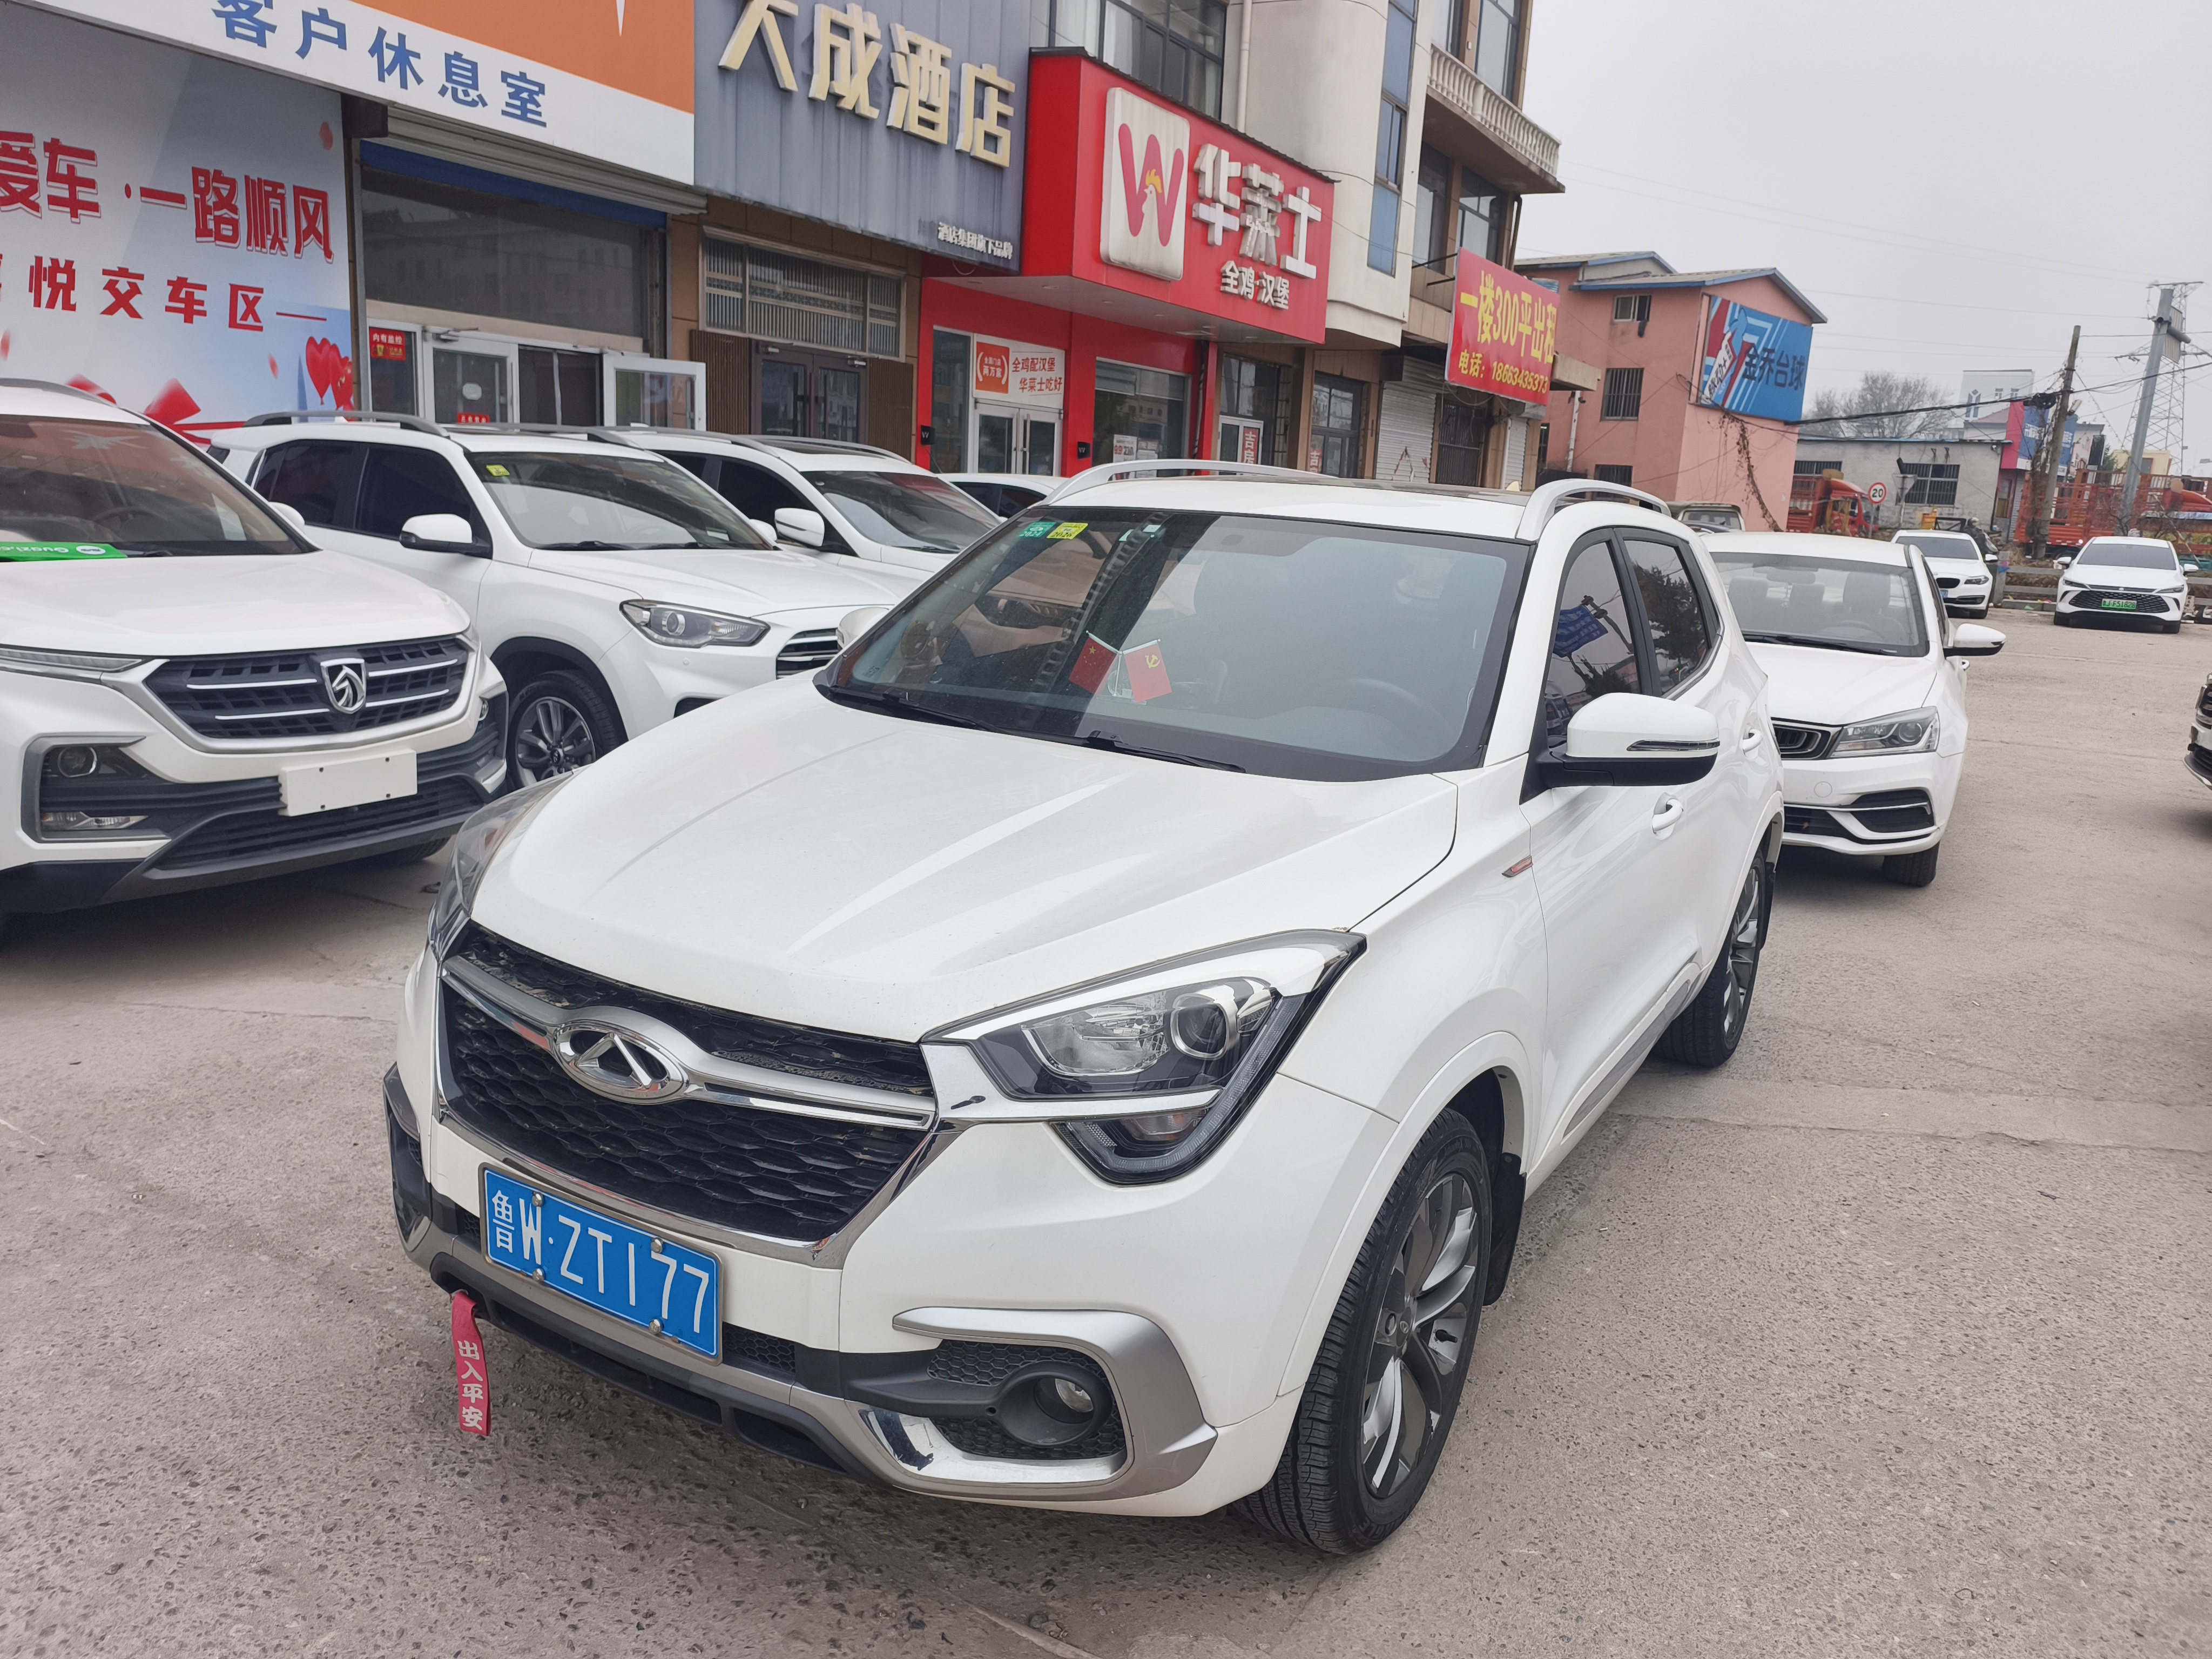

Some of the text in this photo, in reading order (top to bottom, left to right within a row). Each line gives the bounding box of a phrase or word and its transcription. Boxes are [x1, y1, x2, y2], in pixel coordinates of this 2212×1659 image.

[212, 0, 547, 128] 客户休息室
[1192, 143, 1321, 279] 华莱士
[0, 253, 264, 332] 悦交车区
[1460, 270, 1557, 364] 一楼300平出租
[1012, 357, 1056, 373] 全鸡配汉堡
[1492, 361, 1549, 394] 18663435373
[1872, 488, 1884, 498] 20
[456, 1340, 484, 1431] 出入平安
